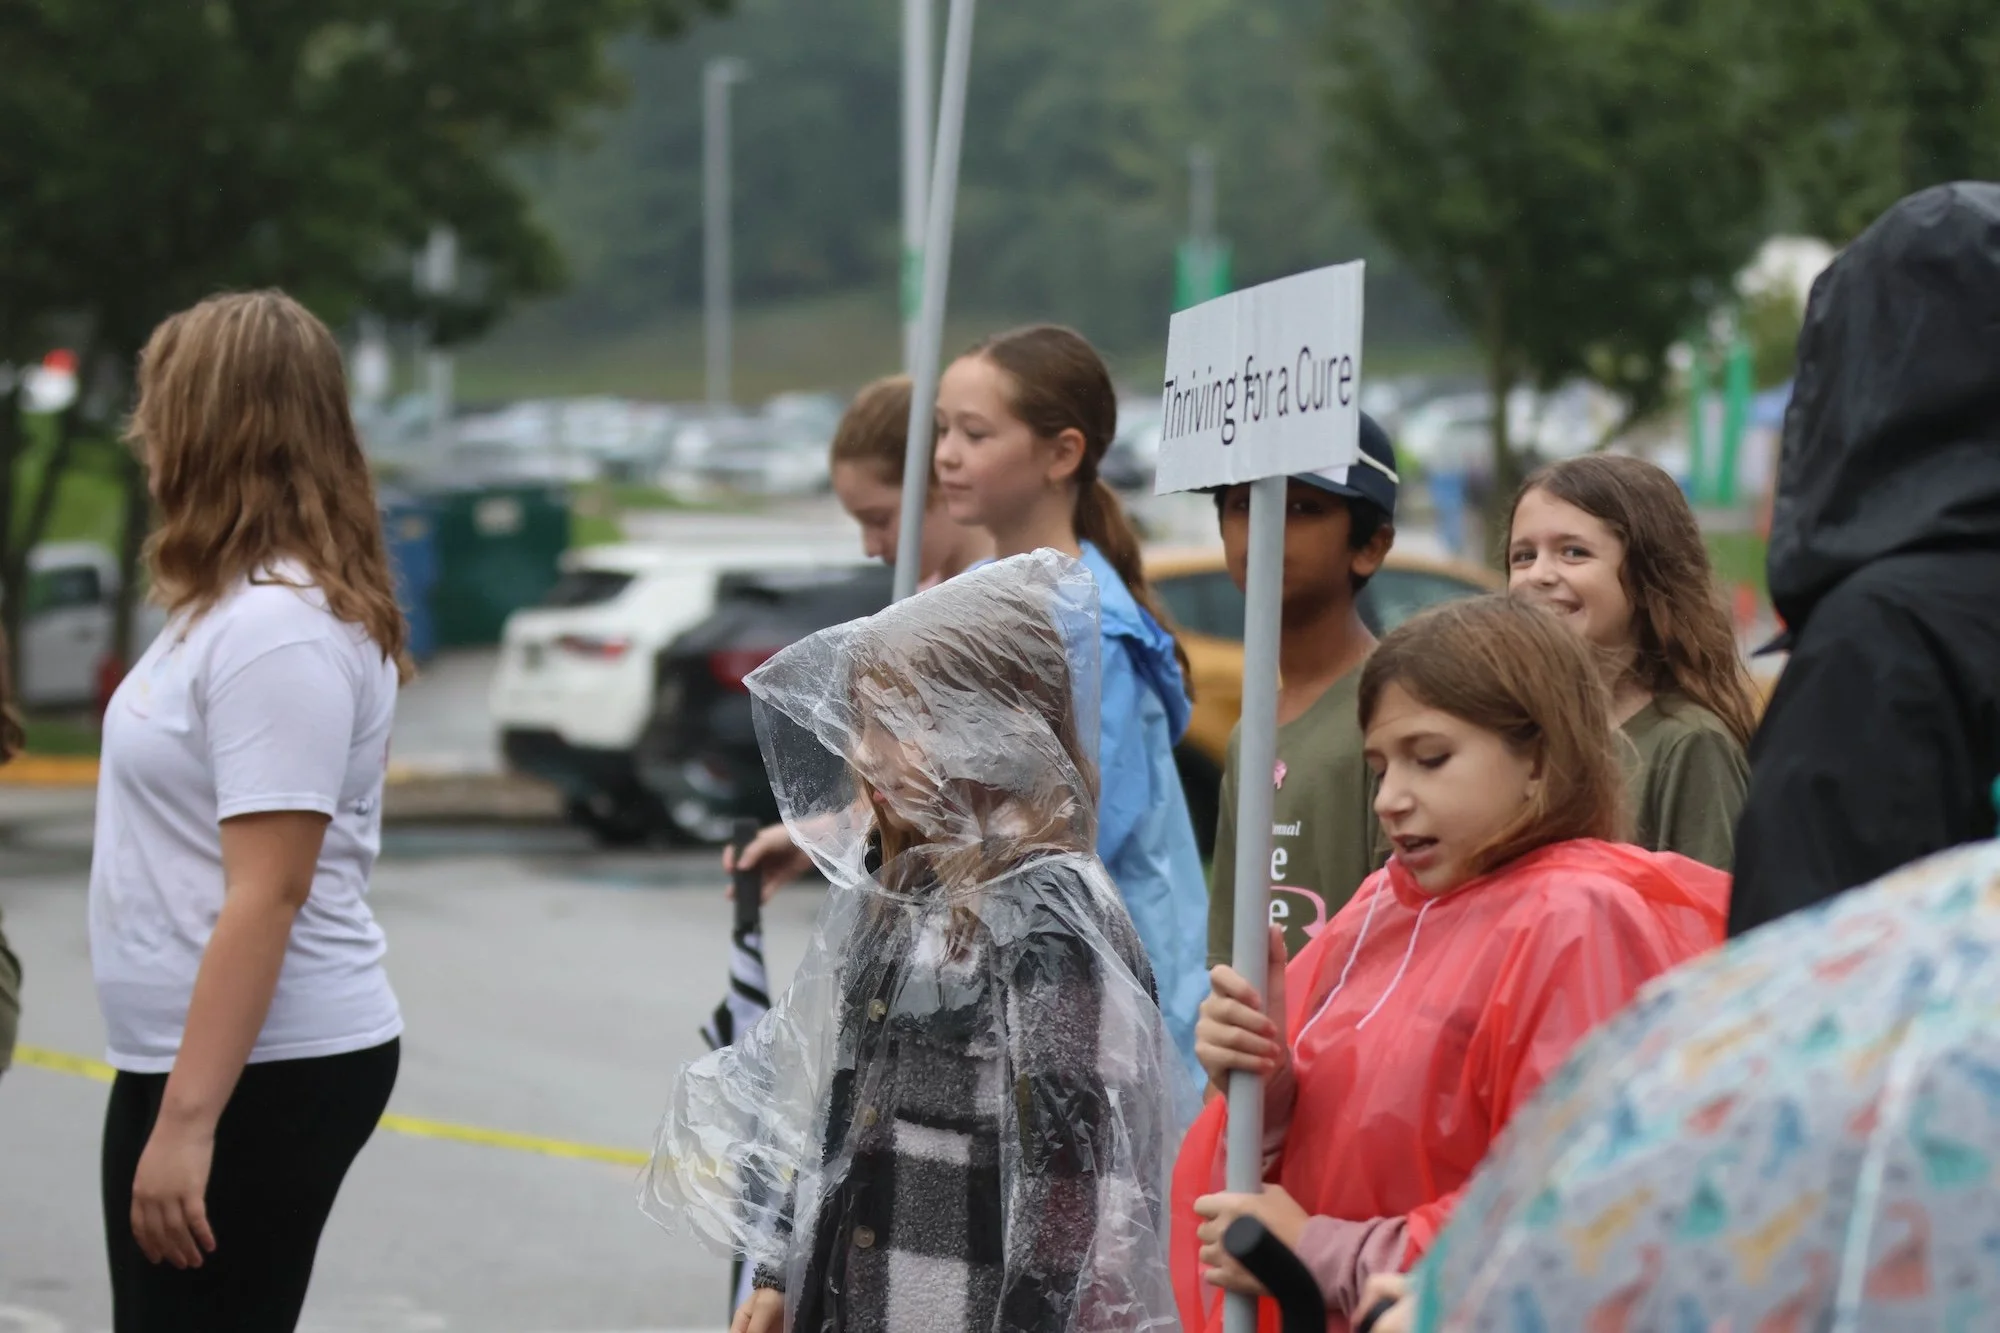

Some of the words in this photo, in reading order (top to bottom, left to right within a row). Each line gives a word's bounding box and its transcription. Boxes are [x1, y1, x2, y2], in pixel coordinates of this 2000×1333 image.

[1163, 366, 1238, 445] Thriving
[1243, 355, 1273, 424] for
[1277, 366, 1289, 417] a
[1295, 346, 1353, 413] Cure
